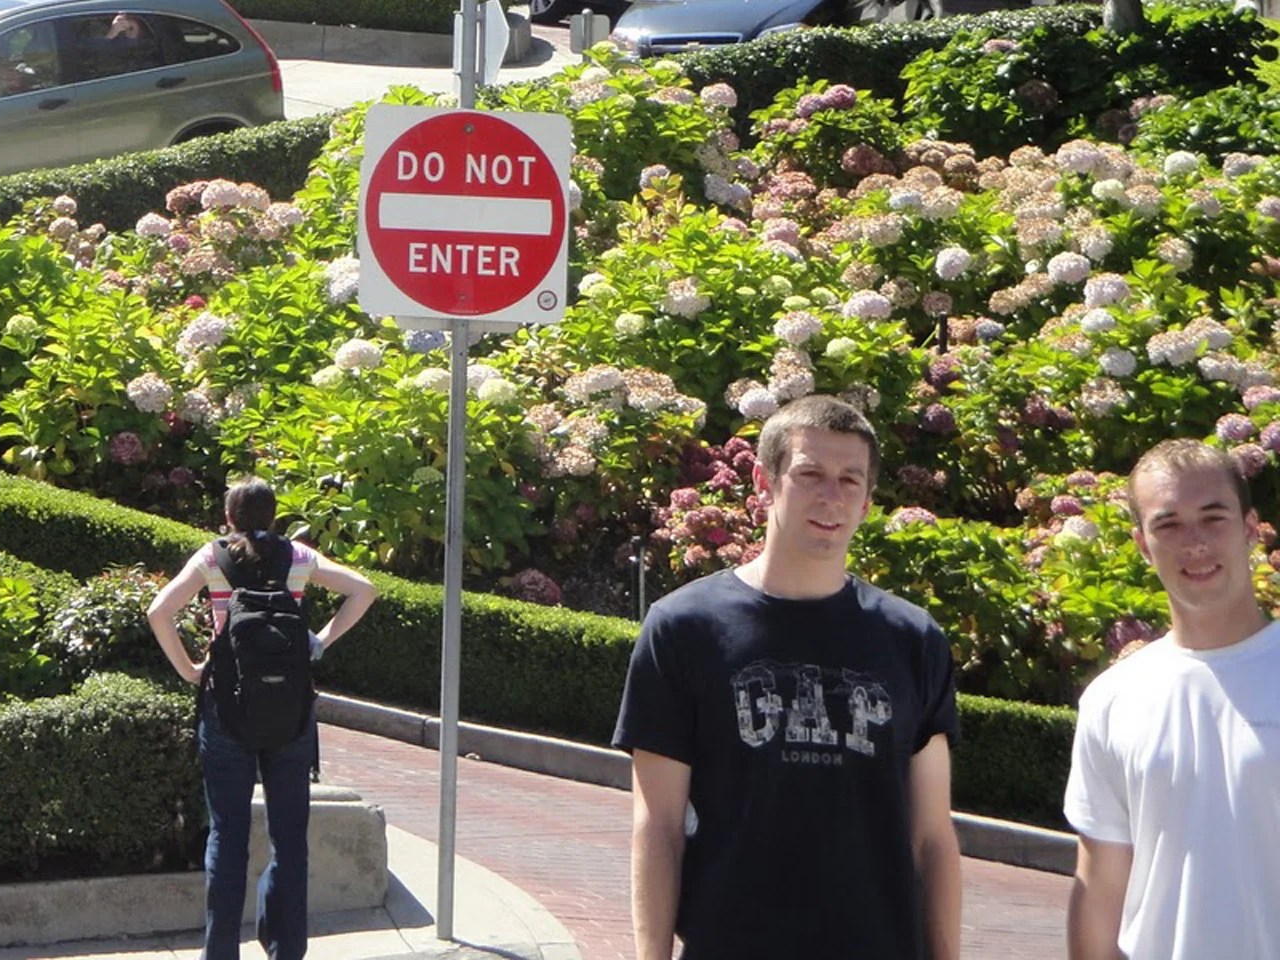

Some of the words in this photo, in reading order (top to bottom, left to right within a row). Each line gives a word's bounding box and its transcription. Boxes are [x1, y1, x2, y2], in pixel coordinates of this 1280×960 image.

[397, 150, 445, 182] DO
[465, 154, 536, 186] NOT
[408, 242, 520, 276] ENTER
[733, 664, 893, 757] GAP
[781, 749, 844, 766] LONDON
